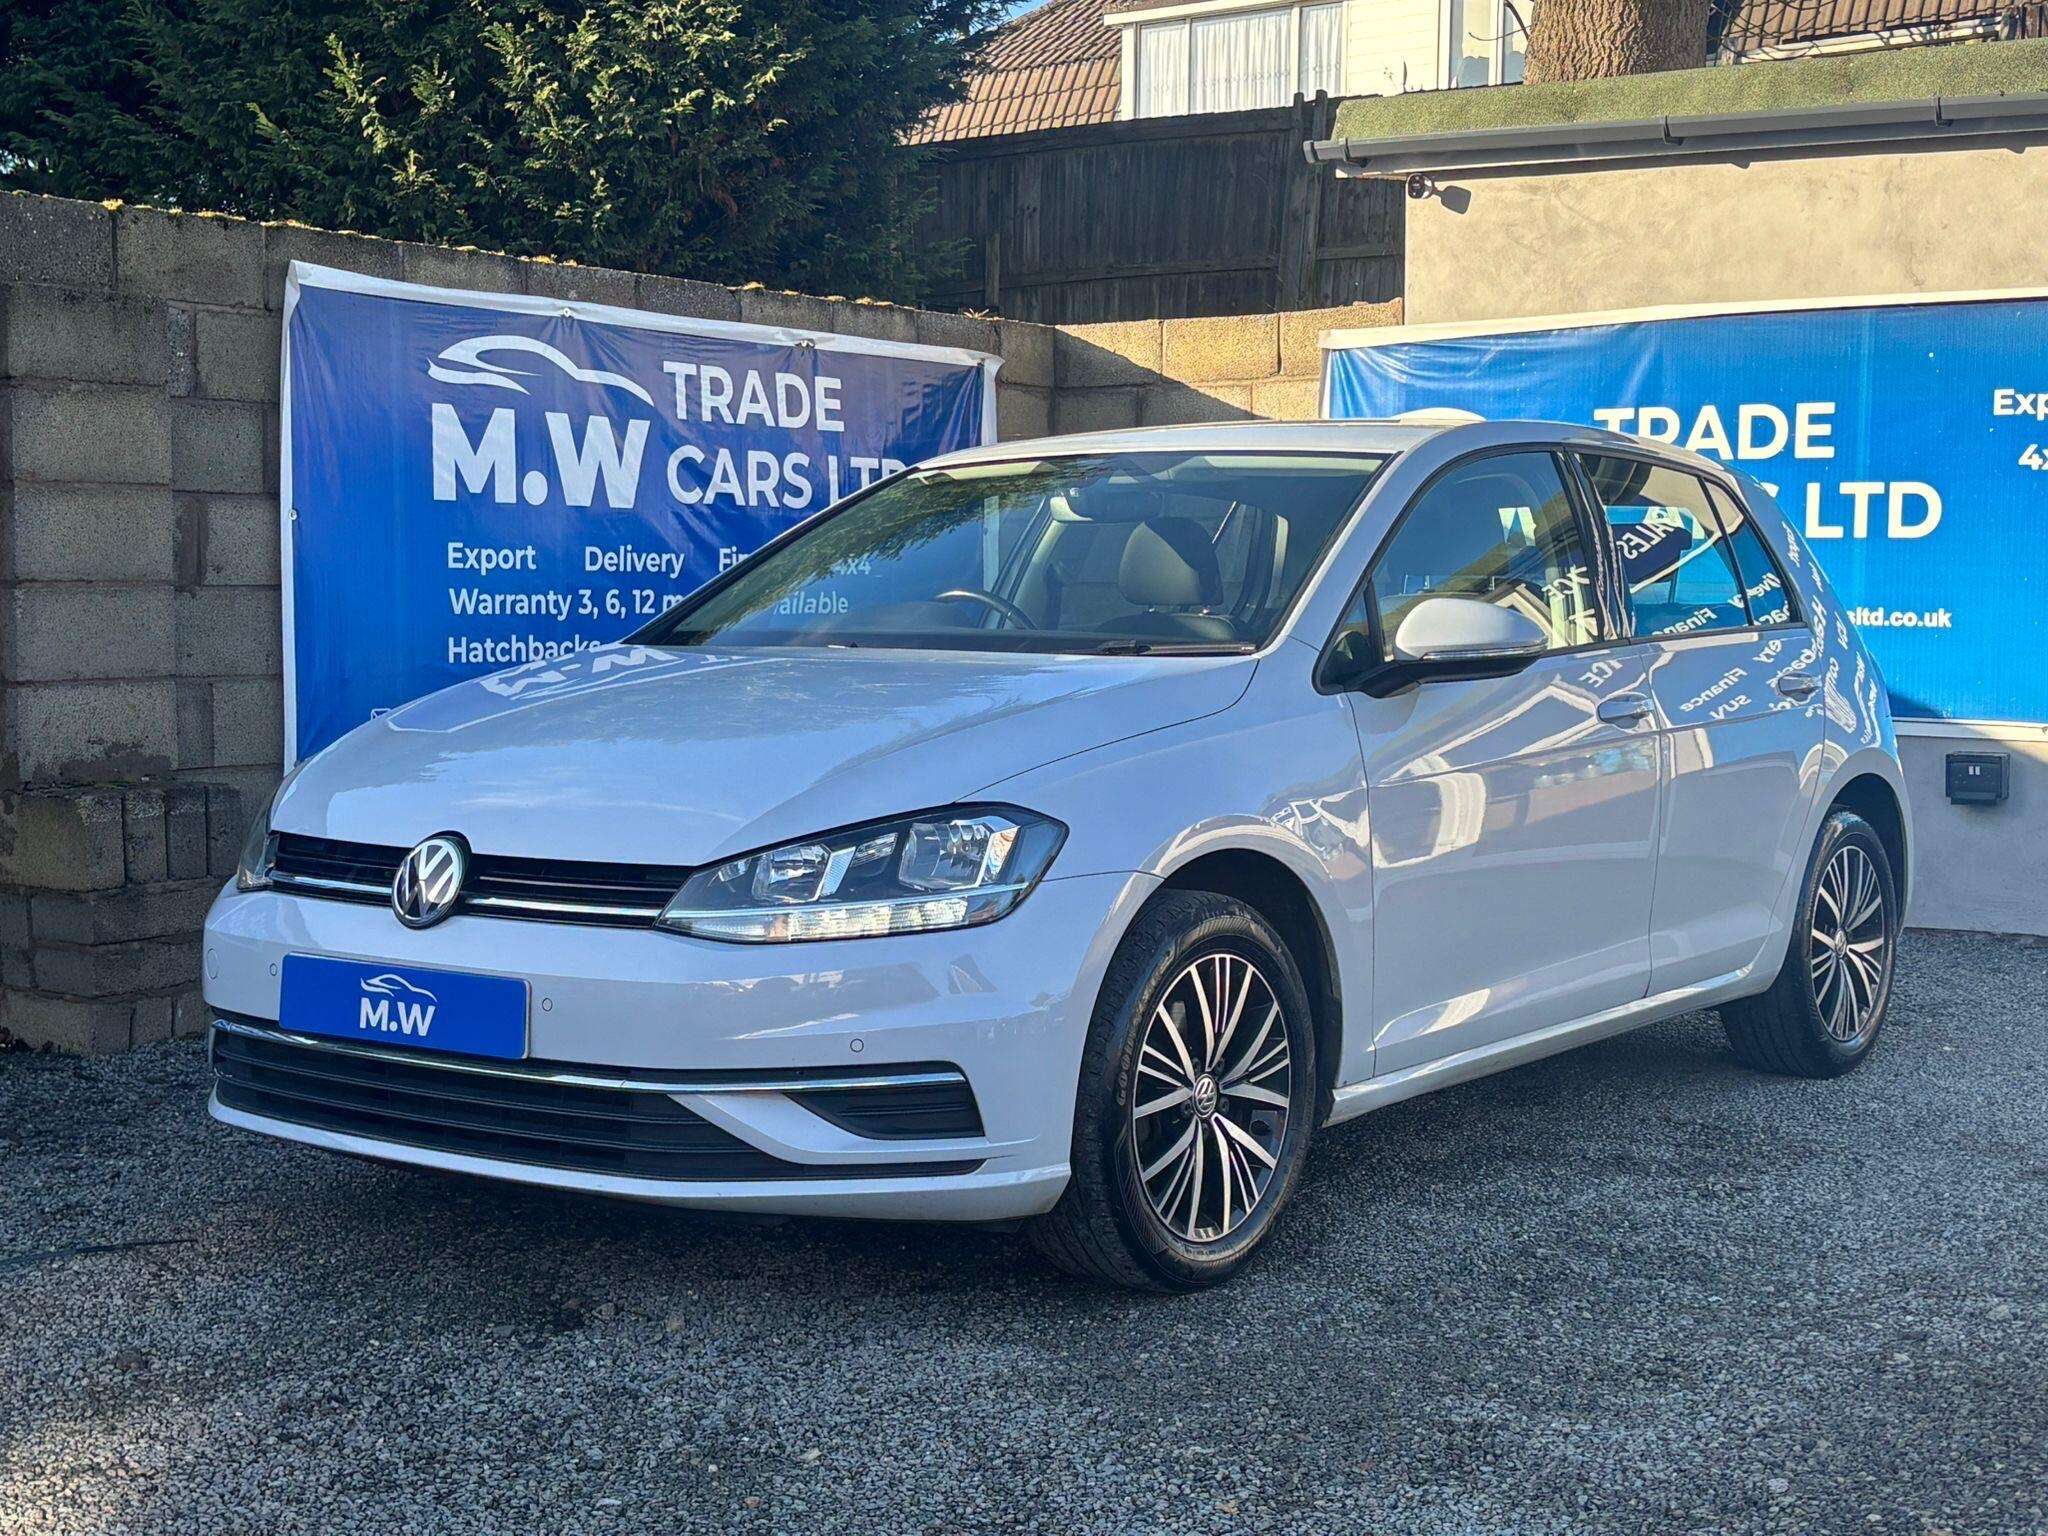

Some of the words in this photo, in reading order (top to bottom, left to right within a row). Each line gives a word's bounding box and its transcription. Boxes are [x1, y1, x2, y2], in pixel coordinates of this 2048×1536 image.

[663, 360, 845, 432] TRADE
[431, 402, 651, 509] M.W
[1594, 401, 1836, 460] TRADE
[666, 444, 813, 509] CARS
[1805, 481, 1943, 539] LTD
[447, 541, 537, 576] Export
[584, 544, 685, 579] Delivery
[449, 587, 573, 621] Warranty
[578, 588, 599, 619] 3,
[605, 587, 627, 619] 6,
[632, 589, 655, 614] 12
[359, 996, 437, 1037] M.W
